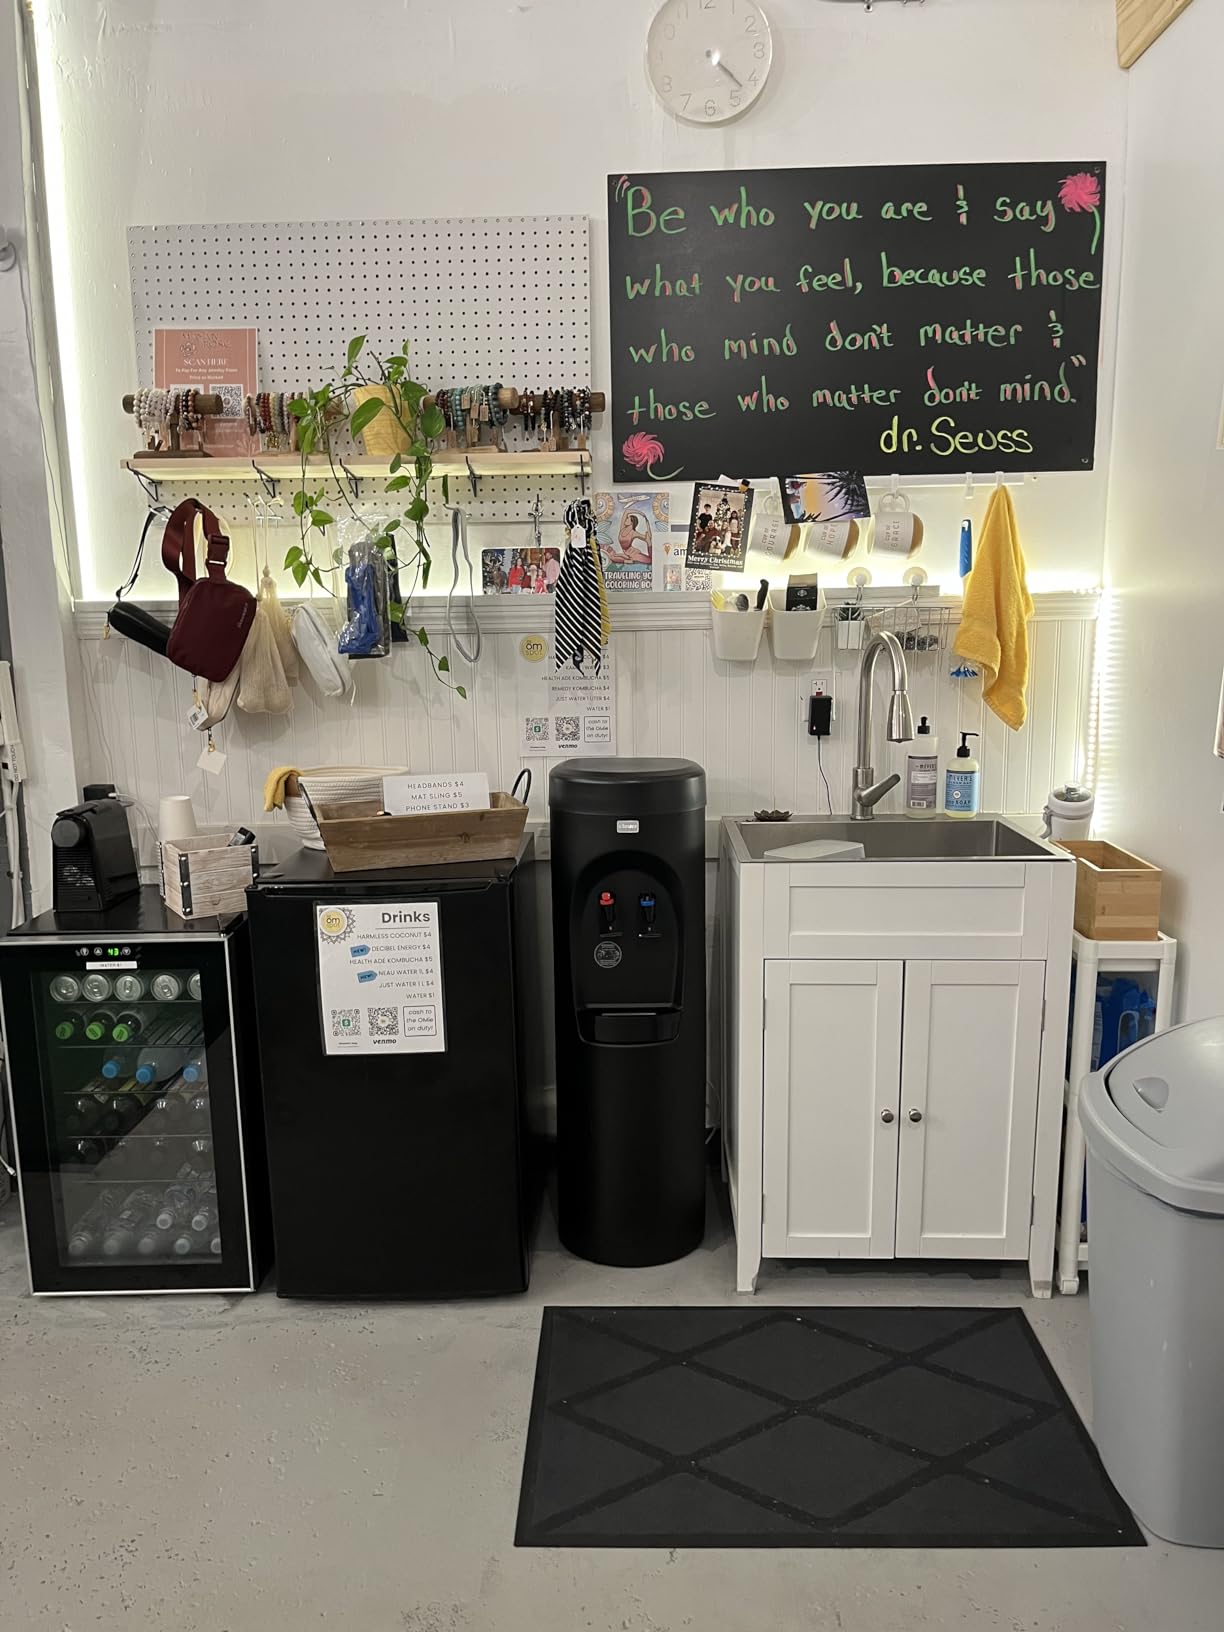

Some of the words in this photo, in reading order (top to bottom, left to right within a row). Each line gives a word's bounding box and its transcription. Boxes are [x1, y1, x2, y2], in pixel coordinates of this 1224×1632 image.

[744, 15, 757, 33] 2
[753, 41, 765, 59] 3
[747, 69, 759, 87] 4
[680, 93, 692, 112] 7
[729, 89, 741, 107] 5
[704, 99, 716, 117] 6
[709, 186, 775, 229] who
[804, 200, 863, 230] you
[881, 201, 933, 221] are
[993, 197, 1056, 233] say
[625, 263, 703, 299] what
[725, 273, 781, 303] you
[796, 257, 863, 295] feel,
[881, 251, 987, 288] because
[1007, 248, 1100, 290] those
[629, 328, 695, 363] who
[724, 322, 798, 360] mind
[825, 320, 894, 352] don't
[919, 319, 1023, 347] matter
[626, 388, 717, 426] those
[737, 375, 790, 413] who
[811, 383, 902, 411] matter
[923, 365, 983, 407] don't
[880, 415, 923, 453] dr.
[930, 416, 1034, 457] Seuss
[688, 555, 708, 564] Merry
[709, 556, 743, 566] Christmas
[604, 571, 641, 580] TRAVELING
[605, 580, 640, 589] COLORING
[641, 580, 652, 589] BO
[407, 781, 453, 790] HEADBANDS
[429, 792, 451, 800] SLING
[381, 910, 431, 924] Drinks
[107, 947, 119, 956] 43
